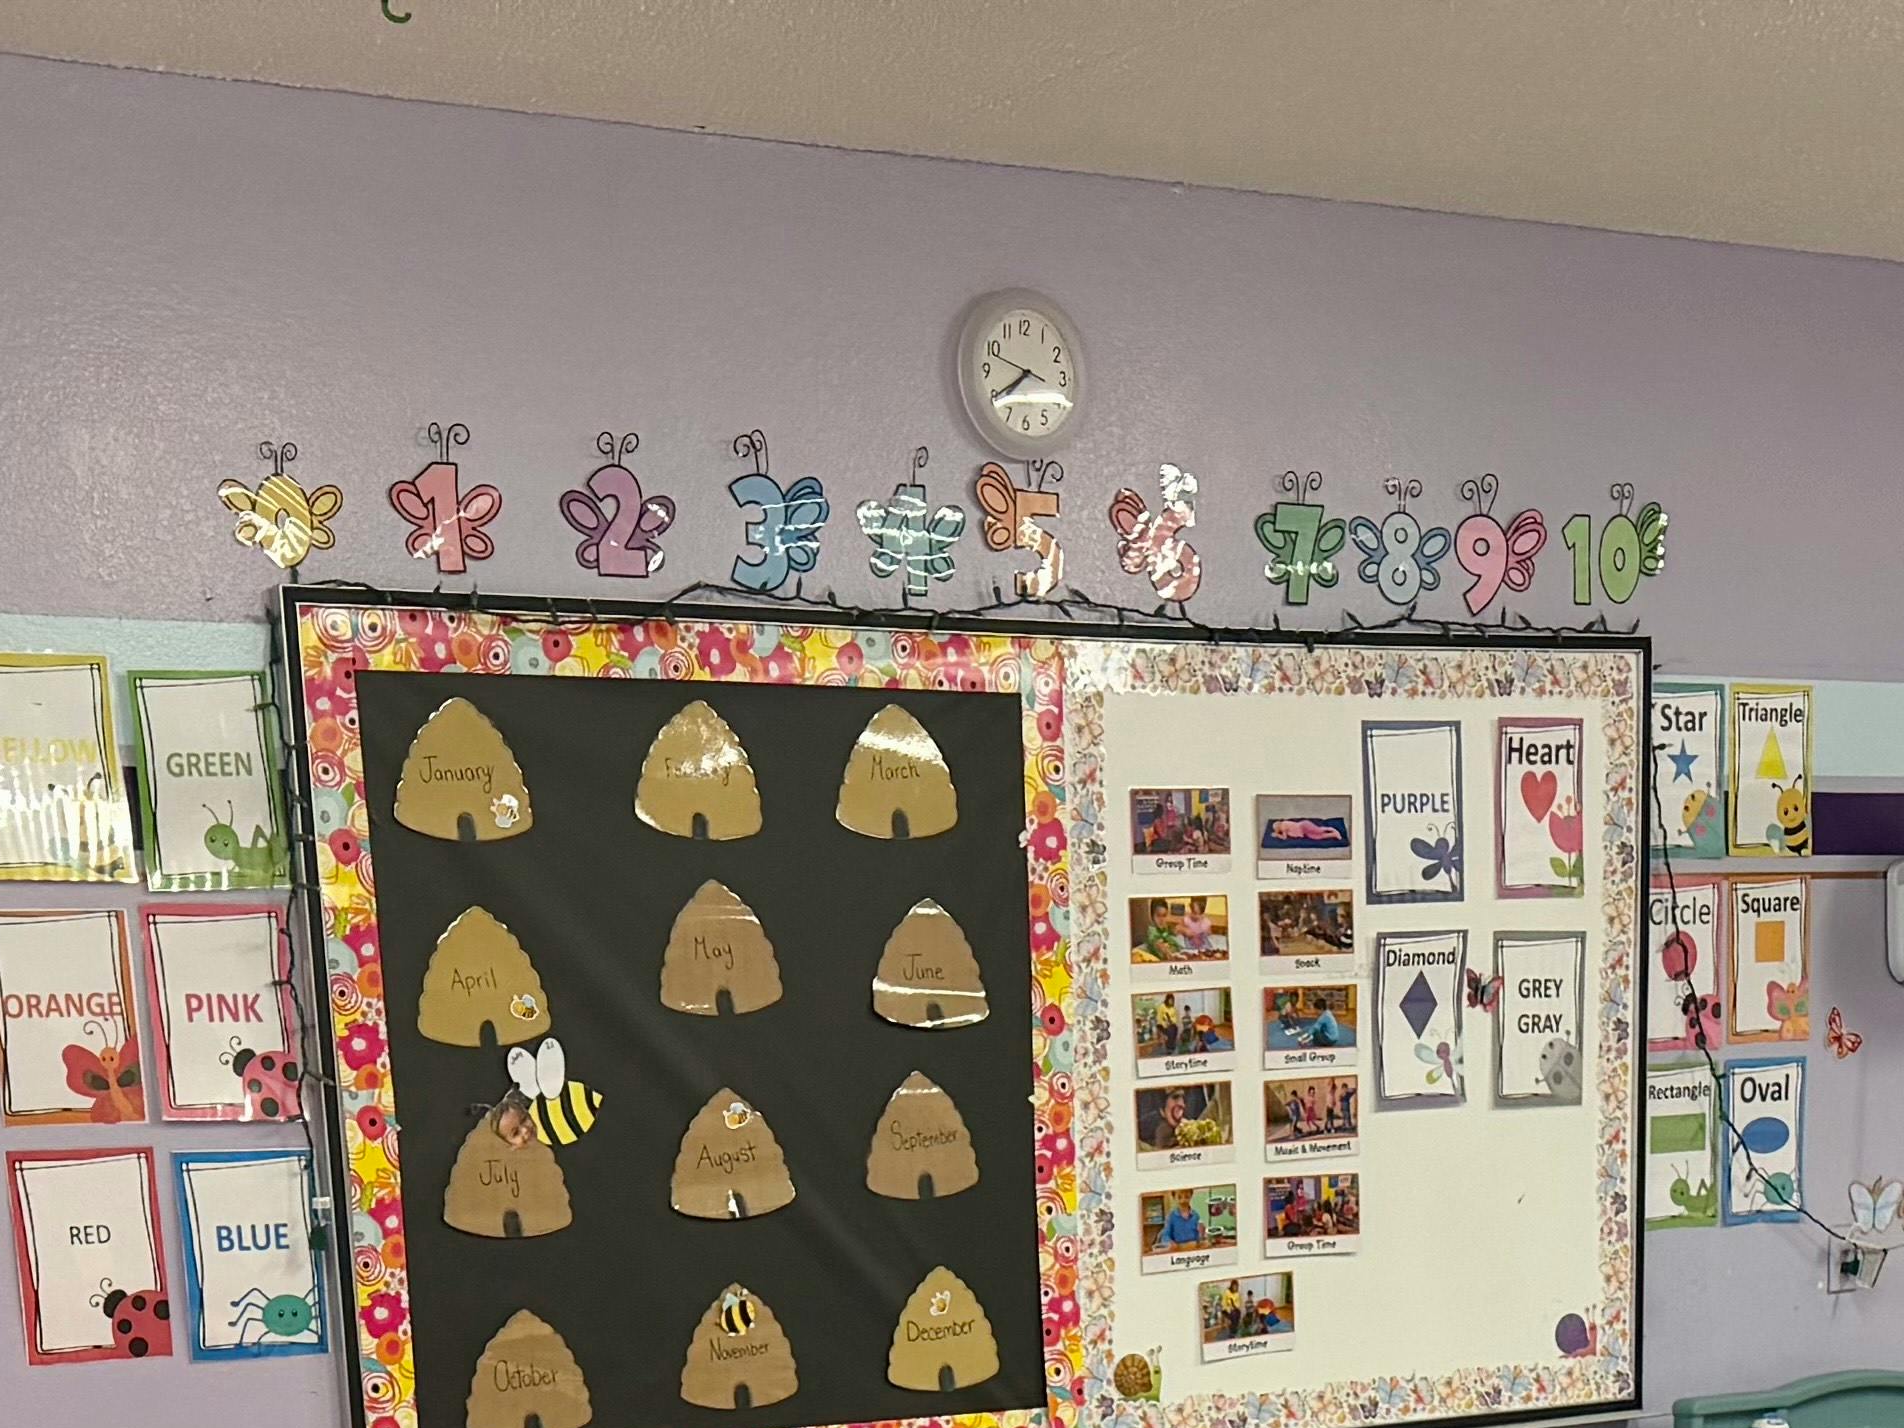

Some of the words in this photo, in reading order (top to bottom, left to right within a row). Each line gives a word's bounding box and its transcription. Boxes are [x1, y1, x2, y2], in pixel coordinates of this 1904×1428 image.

[1002, 323, 1012, 340] 11
[1019, 319, 1031, 337] 12
[987, 340, 1001, 357] 10
[1052, 346, 1062, 363] 2
[982, 362, 991, 379] 9
[1059, 371, 1067, 388] 3
[1004, 406, 1013, 422] 7
[1022, 415, 1030, 431] 6
[1040, 409, 1049, 426] 5
[413, 462, 467, 573] 1
[587, 465, 649, 577] 2
[729, 474, 787, 590] 3
[1012, 490, 1065, 599] 5
[1274, 503, 1325, 605] 7
[1377, 512, 1423, 605] 8
[1455, 515, 1510, 616] 9
[1562, 513, 1643, 605] 10
[1659, 703, 1708, 734] Star
[1738, 701, 1805, 728] Triangle
[166, 750, 254, 779] GREEN
[1507, 736, 1575, 767] Heart
[418, 755, 496, 795] January
[869, 755, 921, 782] March
[1380, 792, 1450, 815] PURPLE
[1156, 858, 1185, 872] Group
[1286, 862, 1322, 876] Naptime
[1649, 896, 1712, 927] Circle
[1740, 892, 1801, 919] Square
[693, 935, 735, 970] May
[1386, 946, 1457, 969] Diamond
[902, 953, 945, 982] June
[1168, 964, 1194, 977] Math
[450, 966, 497, 999] April
[1517, 977, 1564, 1000] GREY
[3, 991, 123, 1020] ORANGE
[185, 993, 264, 1024] PINK
[1516, 1012, 1563, 1036] GRAY
[1648, 1080, 1711, 1102] Rectangle
[1740, 1074, 1790, 1104] Oval
[890, 1121, 959, 1153] September
[1301, 1143, 1309, 1154] &
[1310, 1140, 1352, 1156] Movement
[696, 1143, 758, 1176] August
[479, 1158, 520, 1199] July
[69, 1223, 111, 1247] RED
[215, 1224, 290, 1252] BLUE
[1170, 1251, 1211, 1269] Language
[906, 1315, 978, 1344] December
[709, 1338, 770, 1365] November
[493, 1360, 560, 1395] October
